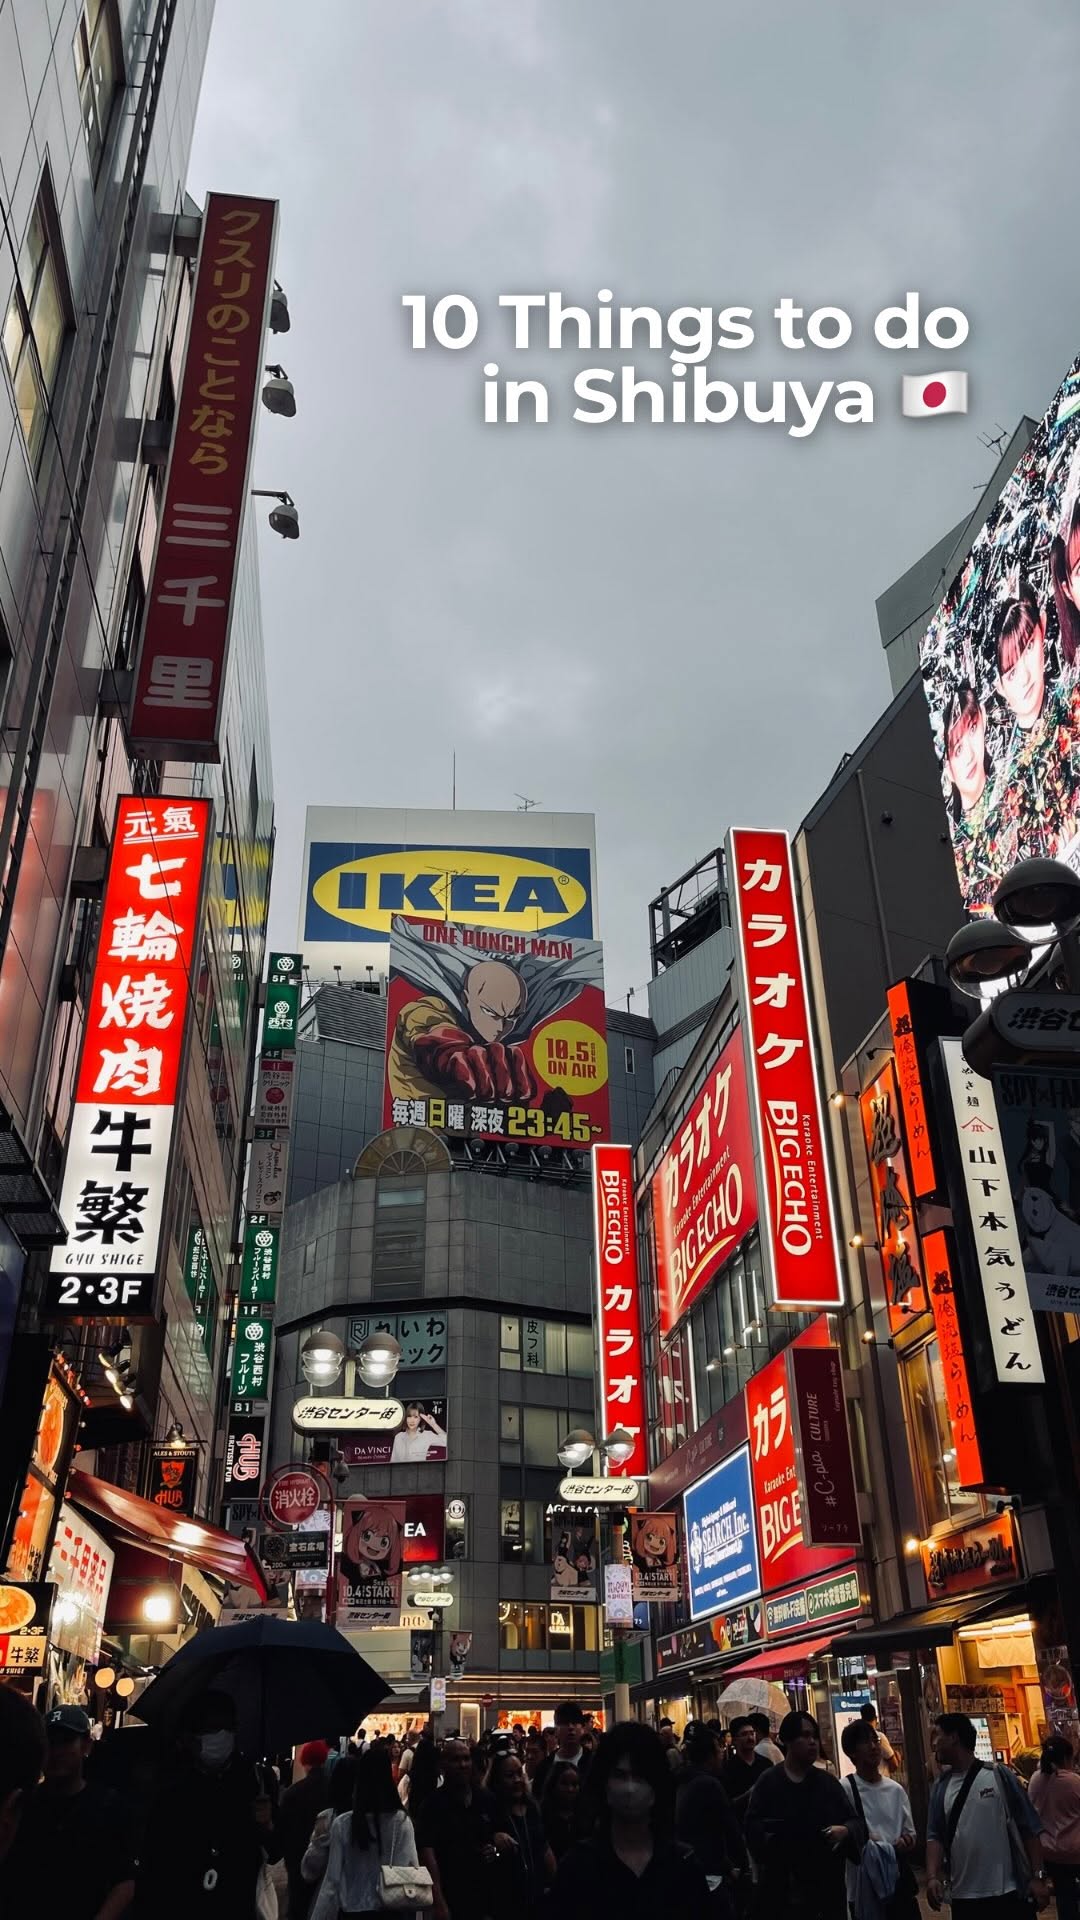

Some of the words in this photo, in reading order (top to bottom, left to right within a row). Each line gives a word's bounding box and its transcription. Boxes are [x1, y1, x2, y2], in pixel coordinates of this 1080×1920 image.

[188, 209, 260, 475] クスリのことなら
[142, 503, 232, 710] 三千里
[123, 806, 196, 836] 元氣
[338, 872, 569, 913] IKEA
[422, 925, 458, 945] ONE
[463, 929, 526, 954] PUNCH
[531, 940, 573, 960] MAN
[741, 859, 804, 1070] カラオケ
[545, 1038, 589, 1062] 10.5
[548, 1062, 568, 1076] ON
[572, 1062, 597, 1079] AIR
[392, 1098, 464, 1130] 毎週日曜
[471, 1106, 504, 1134] 深夜
[667, 1064, 734, 1210] カラオケ
[767, 1100, 800, 1156] BIG
[803, 1114, 814, 1156] Karaoke
[72, 1109, 152, 1246] 牛繁
[601, 1170, 620, 1206] BIG
[250, 1215, 266, 1223] 2F
[699, 1162, 742, 1257] ECHO
[782, 1160, 813, 1256] ECHO
[808, 1160, 824, 1240] Entertainment
[604, 1209, 623, 1265] ECHO
[102, 1253, 143, 1267] SHIGE
[968, 1146, 1032, 1371] 山下本気うどん
[243, 1306, 258, 1315] 1F
[251, 1342, 266, 1387] 渋谷西村
[527, 1321, 539, 1367] 皮フ科
[237, 1353, 251, 1395] フルーツ
[235, 1403, 250, 1412] B1
[298, 1405, 398, 1421] 渋谷センター街
[753, 1385, 794, 1462] カラ
[806, 1392, 822, 1441] CULTURE
[232, 1433, 262, 1482] HUB
[354, 1447, 366, 1455] DA
[367, 1446, 391, 1454] VINCI
[154, 1489, 184, 1508] HUB
[275, 1487, 316, 1509] 消火栓
[563, 1484, 634, 1495] 渋谷センター街
[764, 1474, 785, 1494] Karaoke
[760, 1500, 794, 1560] BIG
[11, 1647, 40, 1664] 牛繁
